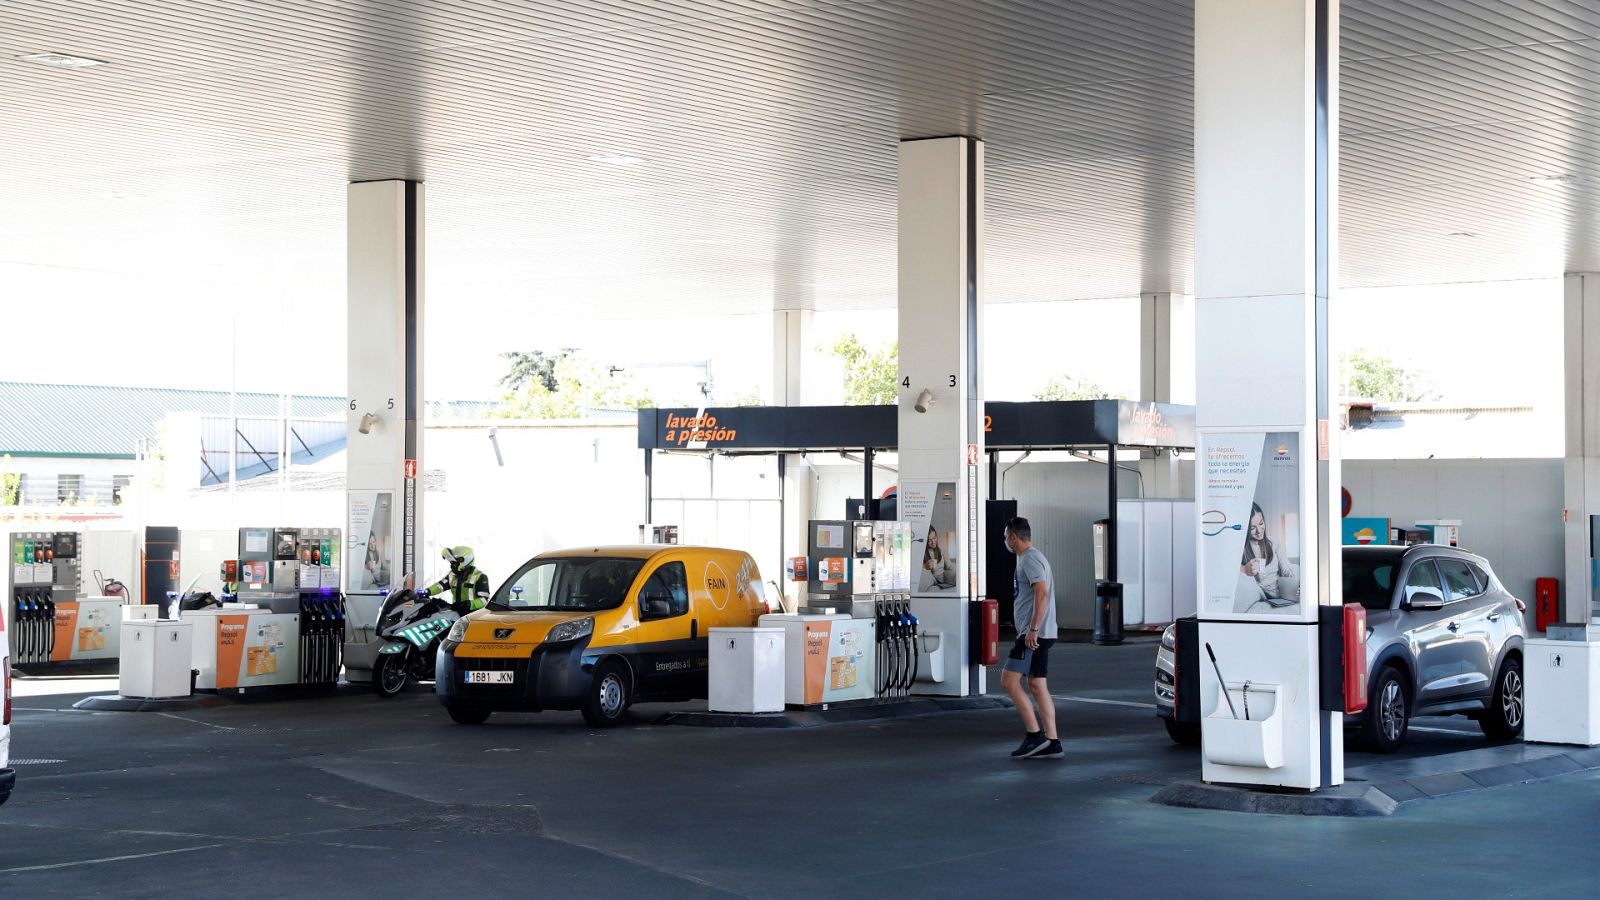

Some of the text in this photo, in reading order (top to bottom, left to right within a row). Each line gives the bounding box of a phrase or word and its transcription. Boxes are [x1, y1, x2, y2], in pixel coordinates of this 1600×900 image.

[902, 376, 910, 388] 4
[949, 375, 956, 387] 3
[350, 400, 356, 410] 6
[388, 399, 394, 409] 5
[665, 412, 717, 428] lavado
[984, 416, 992, 432] 2
[665, 426, 737, 446] a presión
[706, 577, 727, 590] FAIN
[656, 660, 683, 671] Entregados
[472, 672, 512, 682] 1681 JKN
